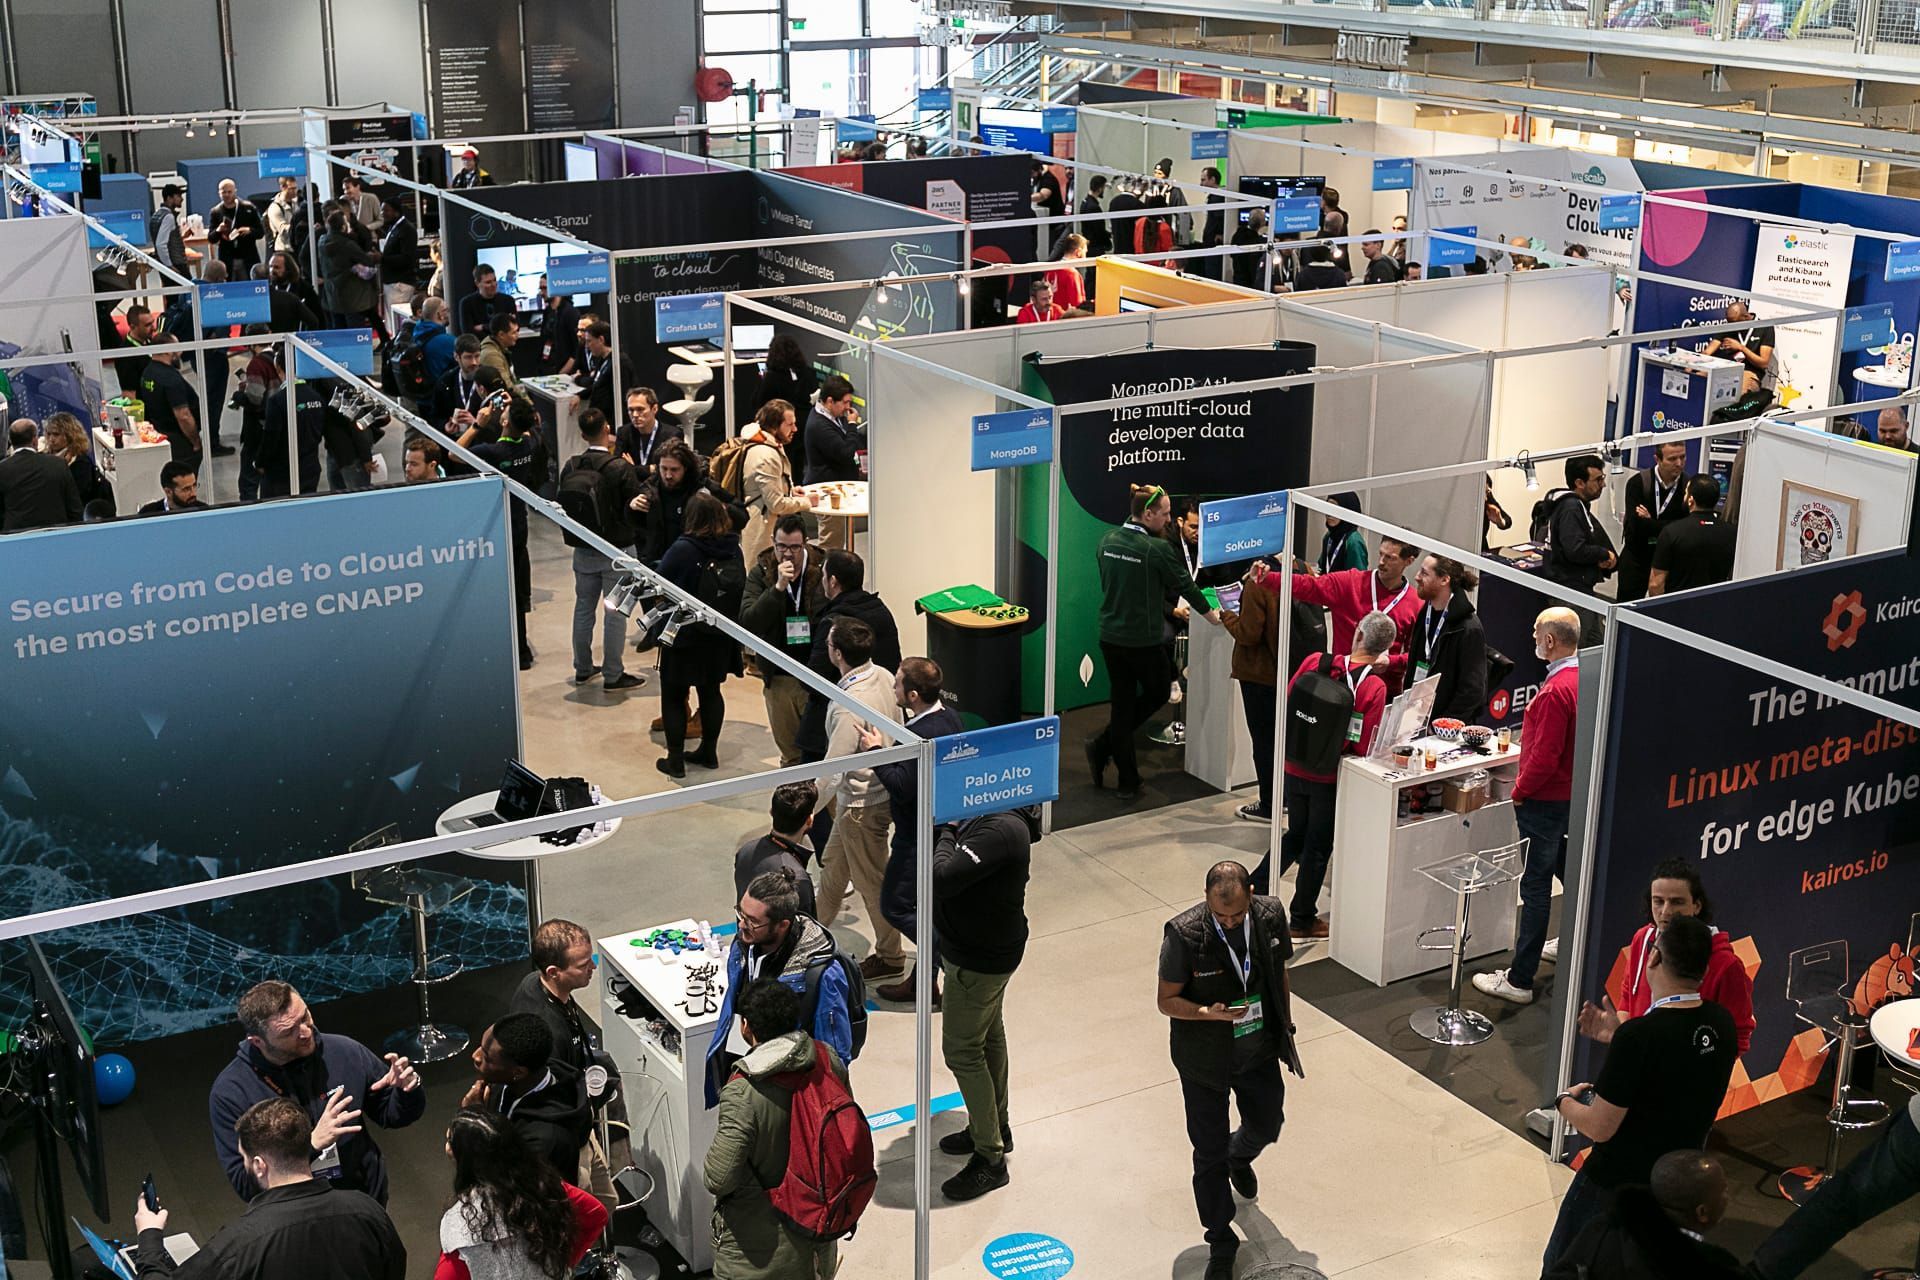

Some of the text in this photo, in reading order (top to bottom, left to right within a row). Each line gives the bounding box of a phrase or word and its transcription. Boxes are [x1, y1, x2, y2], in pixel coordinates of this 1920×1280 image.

[1337, 33, 1409, 66] BOUTIQUE
[1509, 184, 1524, 192] aws
[931, 200, 961, 209] PARTNER
[1568, 192, 1599, 213] Dev
[554, 216, 589, 227] Tanzu
[1800, 239, 1829, 250] elastic
[653, 256, 728, 278] to cloud
[774, 250, 794, 269] Cloud
[795, 258, 835, 281] Kubernetes
[1777, 255, 1829, 268] Elasticsearch
[1779, 265, 1823, 277] and Kibana
[758, 264, 785, 283] At Scale
[1768, 274, 1832, 288] put data to work
[255, 285, 267, 293] D3
[226, 310, 247, 318] Suse
[793, 297, 805, 310] path
[807, 300, 813, 312] to
[814, 303, 847, 324] production
[666, 321, 717, 333] Grafana Labs
[357, 334, 369, 342] D4
[1110, 400, 1252, 422] The multi-cloud
[977, 422, 990, 431] E5
[1666, 418, 1693, 430] elast
[1109, 421, 1245, 447] developer data
[513, 455, 532, 466] SUSE
[990, 445, 1038, 460] MongoDB
[1107, 446, 1186, 472] platform.
[1207, 511, 1220, 523] E6
[1225, 537, 1263, 553] SoKube
[10, 537, 495, 622] Secure from Code to Cloud with
[14, 582, 424, 659] the most complete CNAPP
[1512, 683, 1544, 708] ED
[1749, 686, 1807, 727] The
[1035, 726, 1055, 740] D5
[965, 766, 1032, 789] Palo Alto
[1668, 760, 1761, 808] Linux
[963, 784, 1033, 807] Networks
[1700, 821, 1749, 860] for
[1757, 798, 1835, 841] edge
[1801, 850, 1889, 894] kairos.io
[990, 1239, 1051, 1258] uniquement
[991, 1247, 1064, 1268] carte bancaire
[1001, 1257, 1071, 1277] Paiement par
